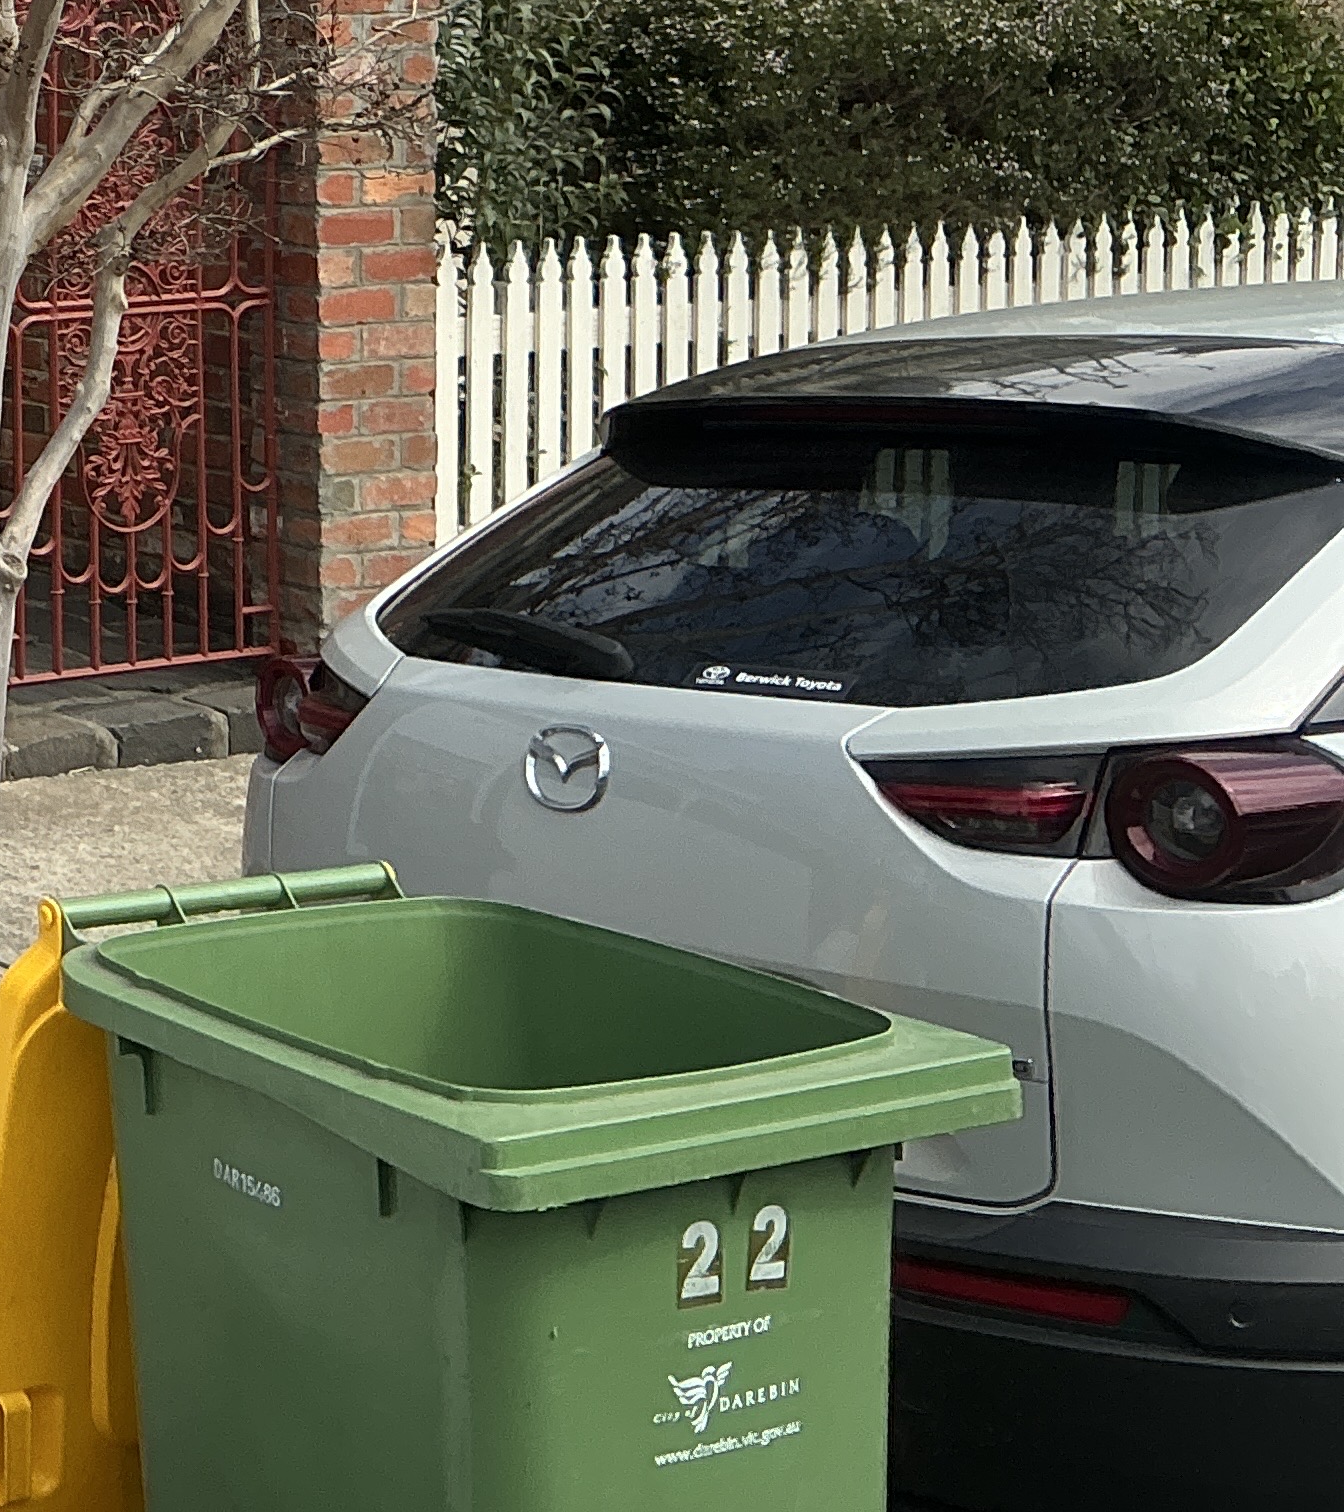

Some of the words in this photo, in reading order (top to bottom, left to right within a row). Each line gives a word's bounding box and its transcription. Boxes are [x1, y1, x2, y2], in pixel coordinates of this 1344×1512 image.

[735, 672, 792, 687] Berwick
[794, 676, 842, 692] Toyota
[213, 1157, 281, 1207] DAR15486
[687, 1320, 752, 1349] PROPERTY
[752, 1315, 772, 1334] OF
[718, 1377, 801, 1413] DAREBIN
